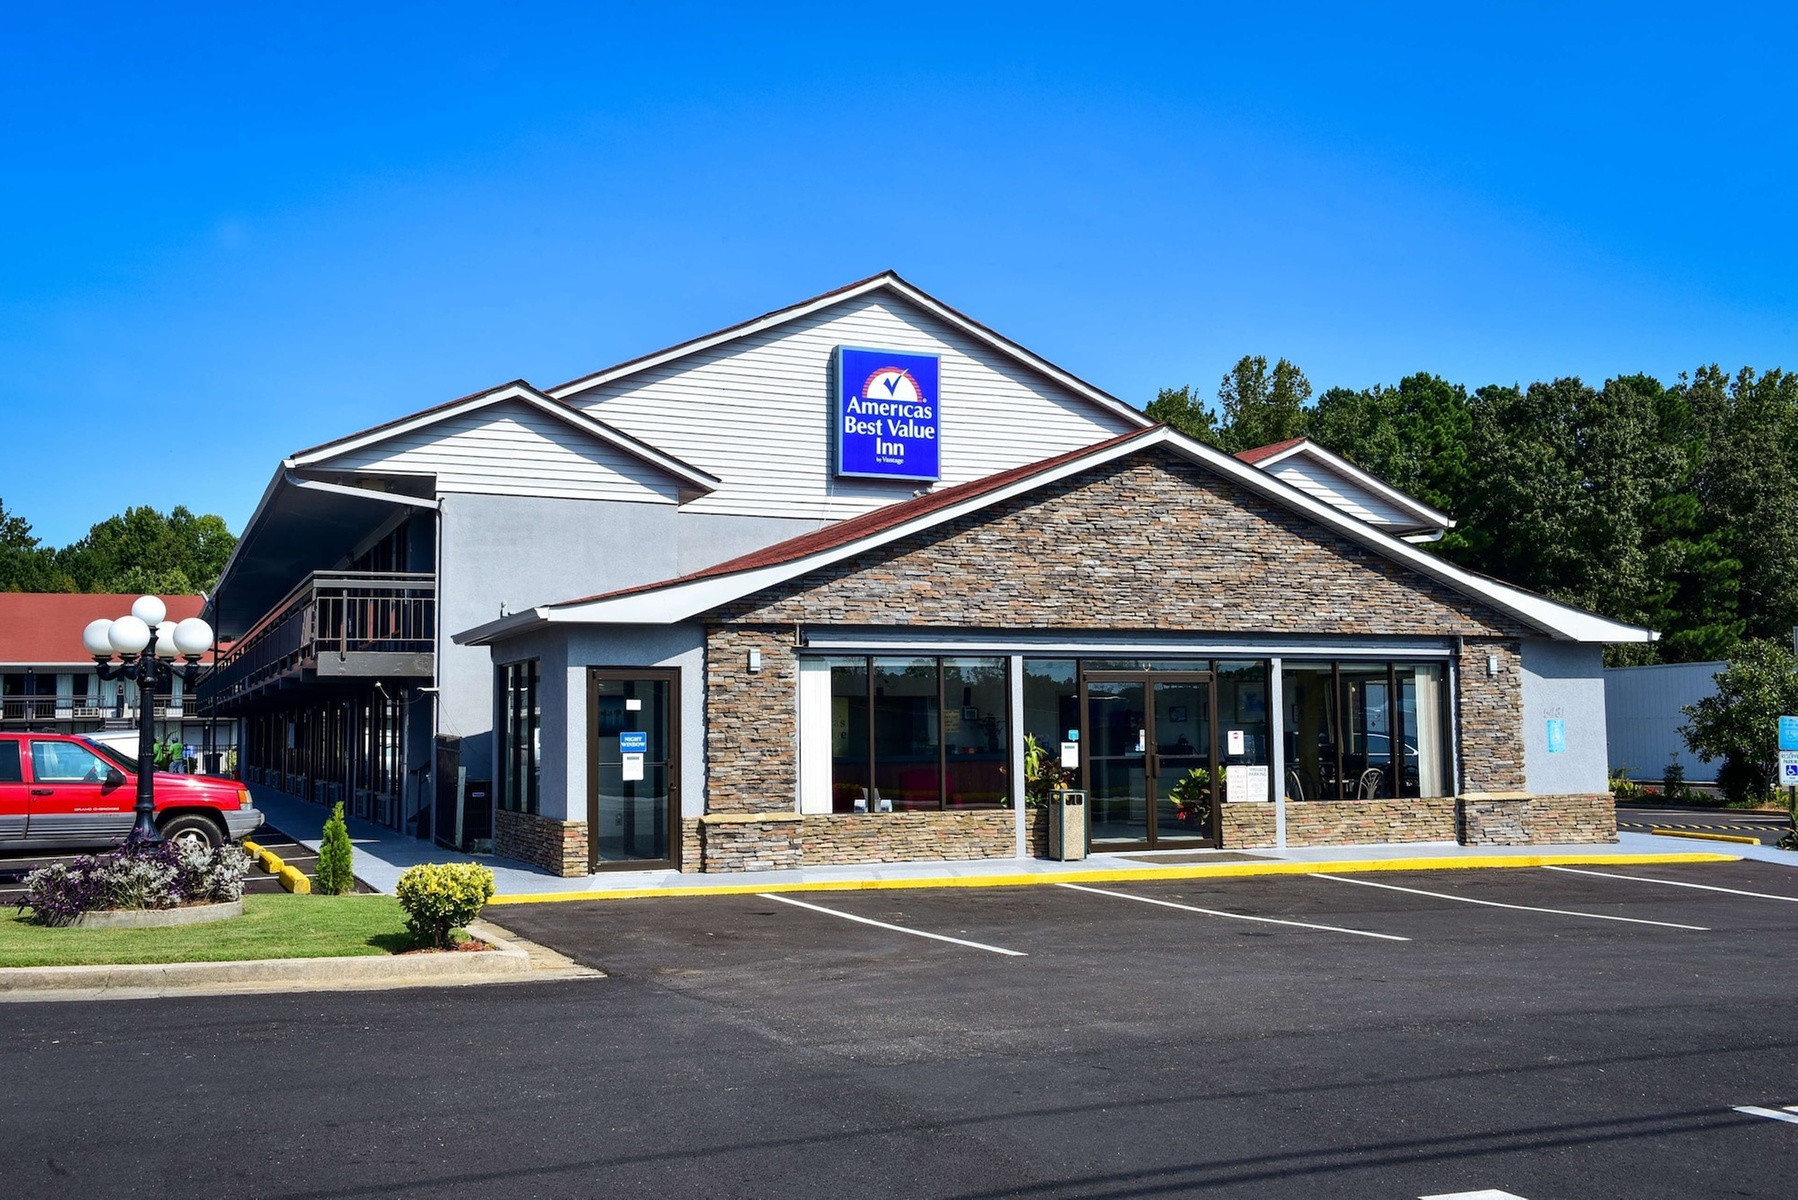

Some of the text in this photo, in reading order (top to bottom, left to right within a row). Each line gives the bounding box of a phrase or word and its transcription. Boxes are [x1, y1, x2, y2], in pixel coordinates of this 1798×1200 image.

[847, 396, 932, 419] Americas
[845, 416, 935, 439] Best Value
[876, 438, 904, 456] Inn
[882, 456, 904, 465] Vantage
